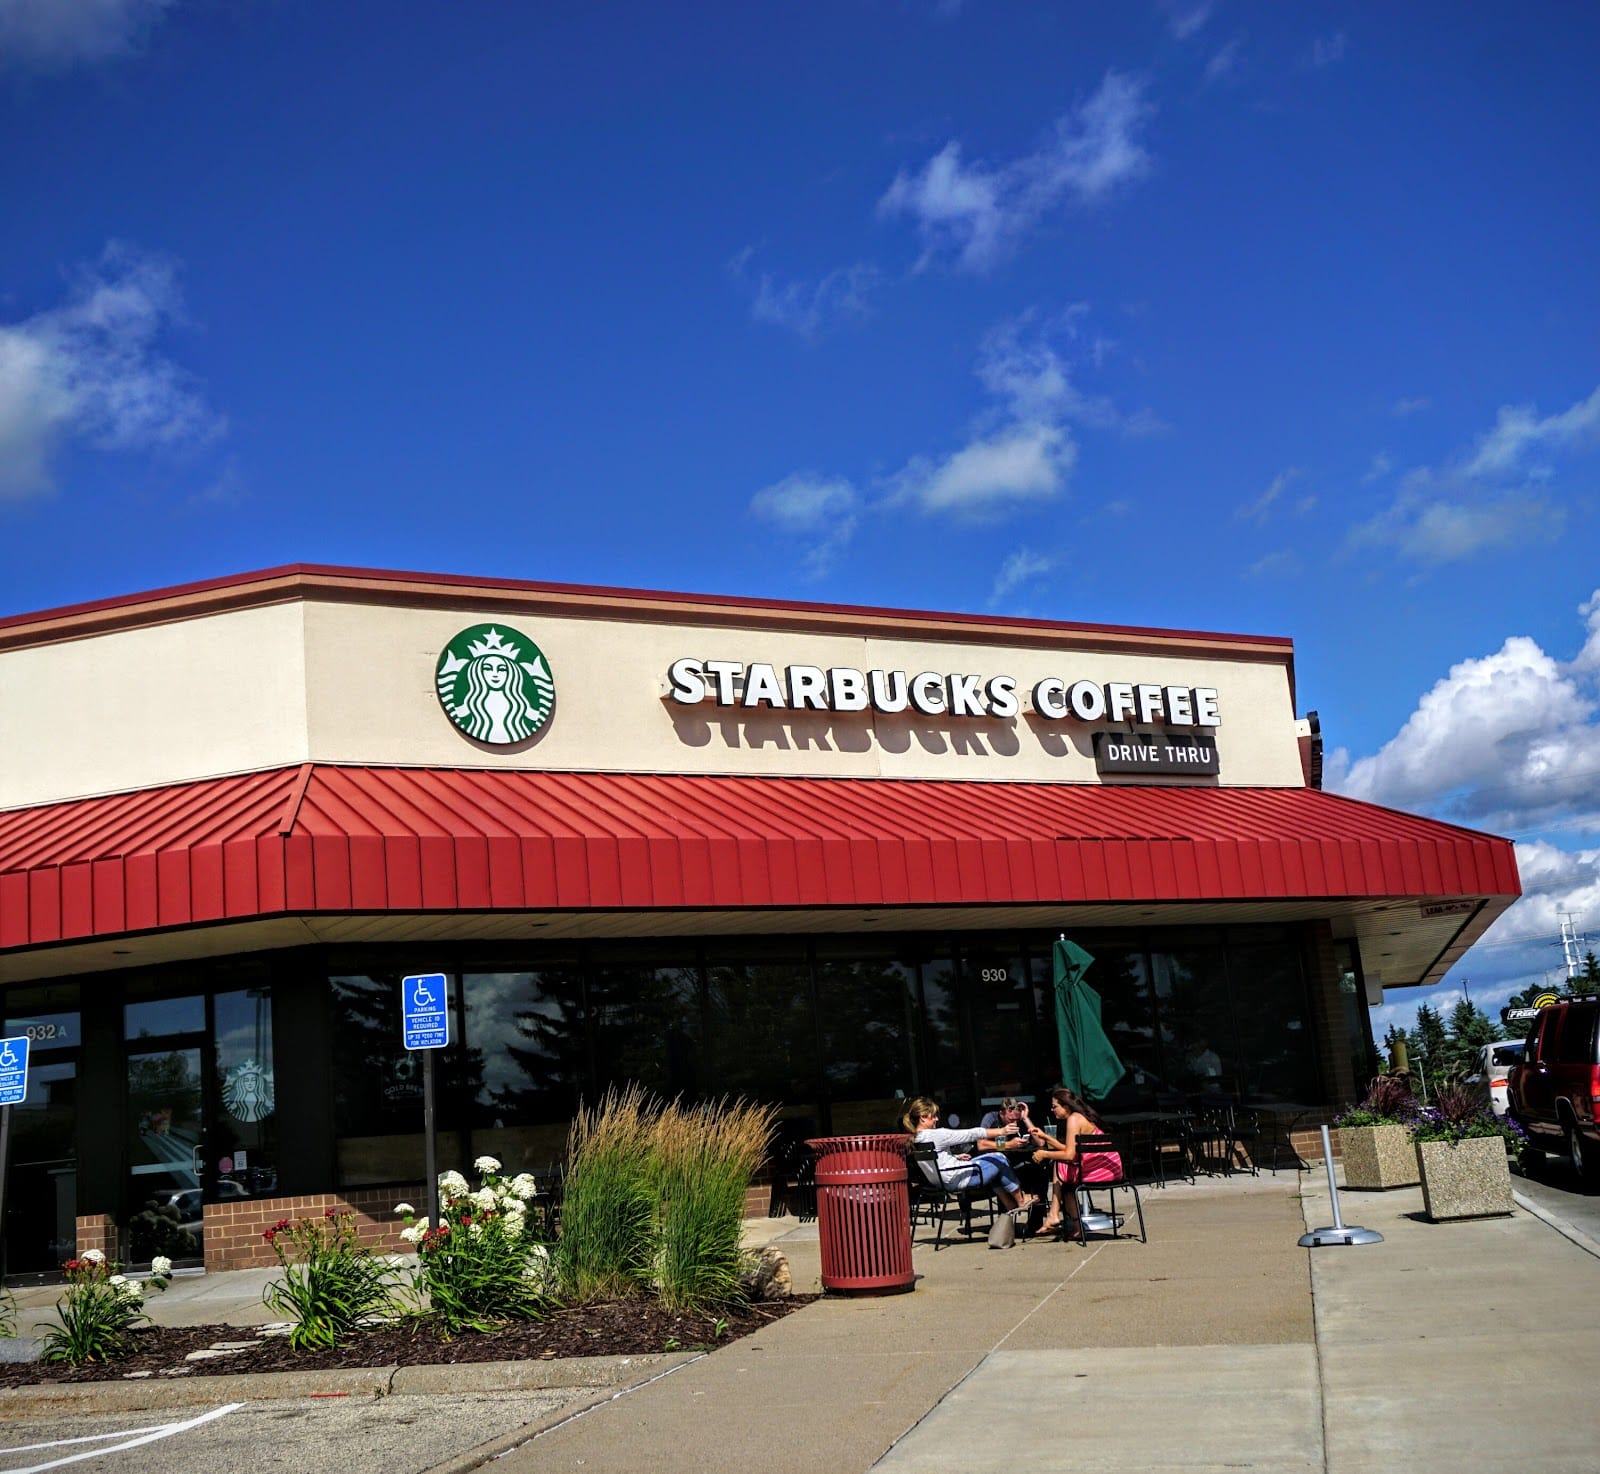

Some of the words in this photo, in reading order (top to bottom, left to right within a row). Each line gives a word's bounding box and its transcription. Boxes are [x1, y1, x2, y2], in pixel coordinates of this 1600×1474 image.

[668, 658, 1018, 718] STARBUCKS
[1032, 677, 1221, 727] COFFEE
[1108, 744, 1160, 762] DRIVE
[1165, 746, 1211, 764] THRU
[981, 968, 1007, 982] 930
[26, 1025, 56, 1040] 932
[59, 1026, 67, 1037] A
